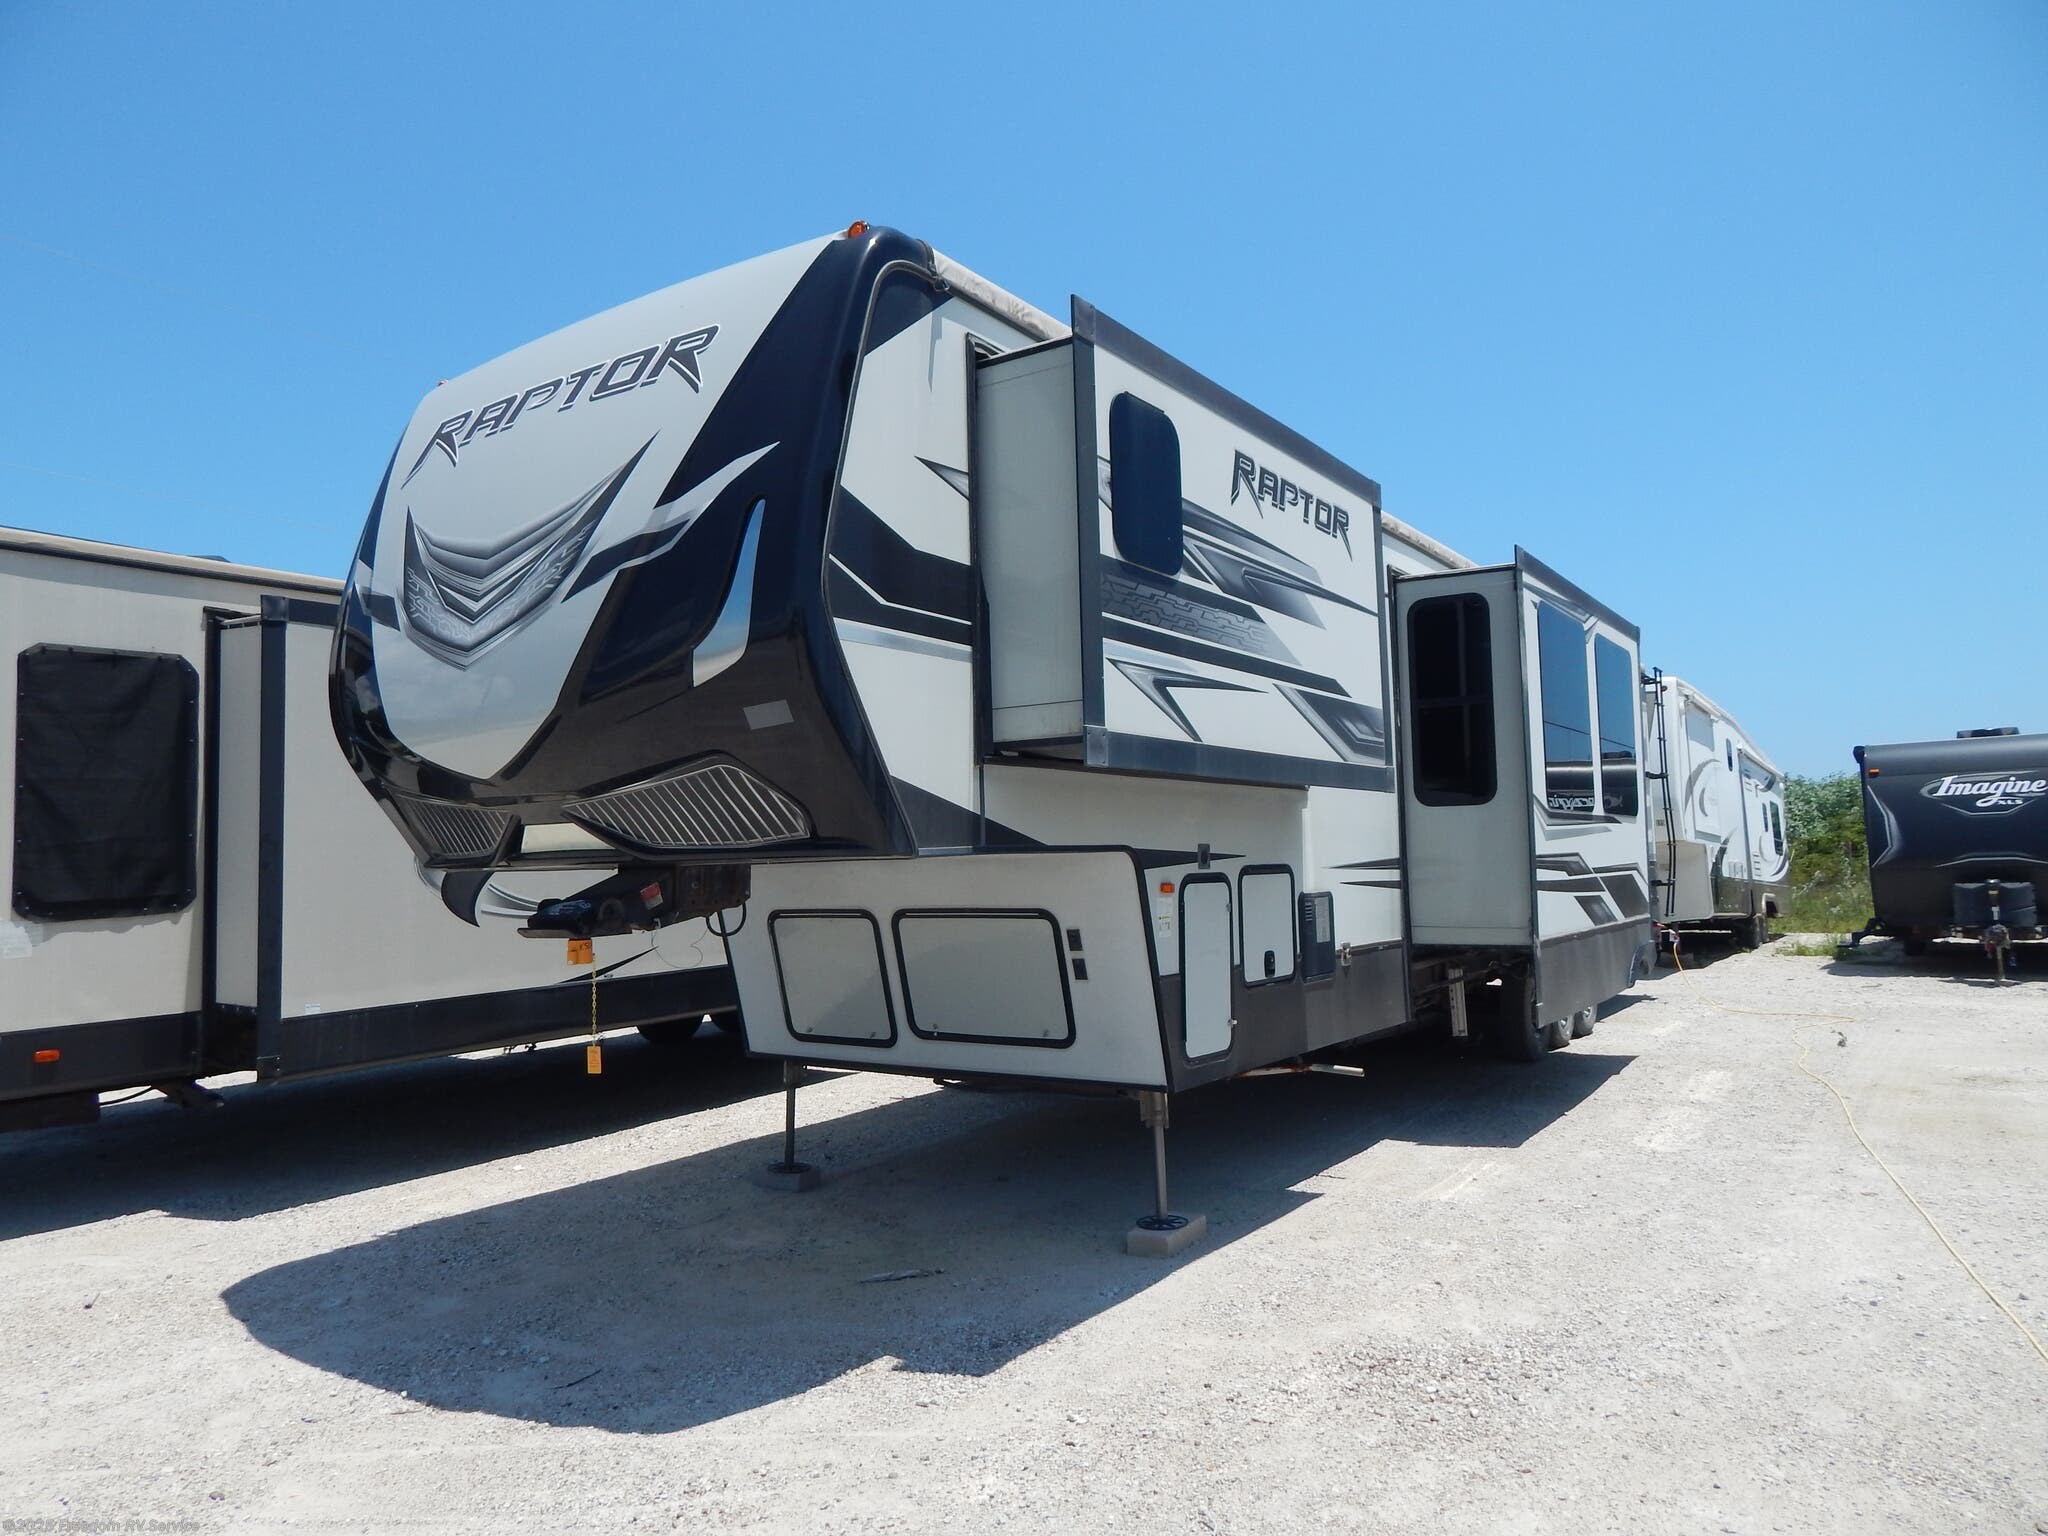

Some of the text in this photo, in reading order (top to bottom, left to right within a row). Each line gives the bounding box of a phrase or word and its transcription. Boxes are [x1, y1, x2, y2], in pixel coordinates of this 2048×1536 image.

[401, 323, 720, 490] RAPTOR
[1230, 449, 1353, 562] RAPTOR
[1932, 775, 2048, 807] Imagine
